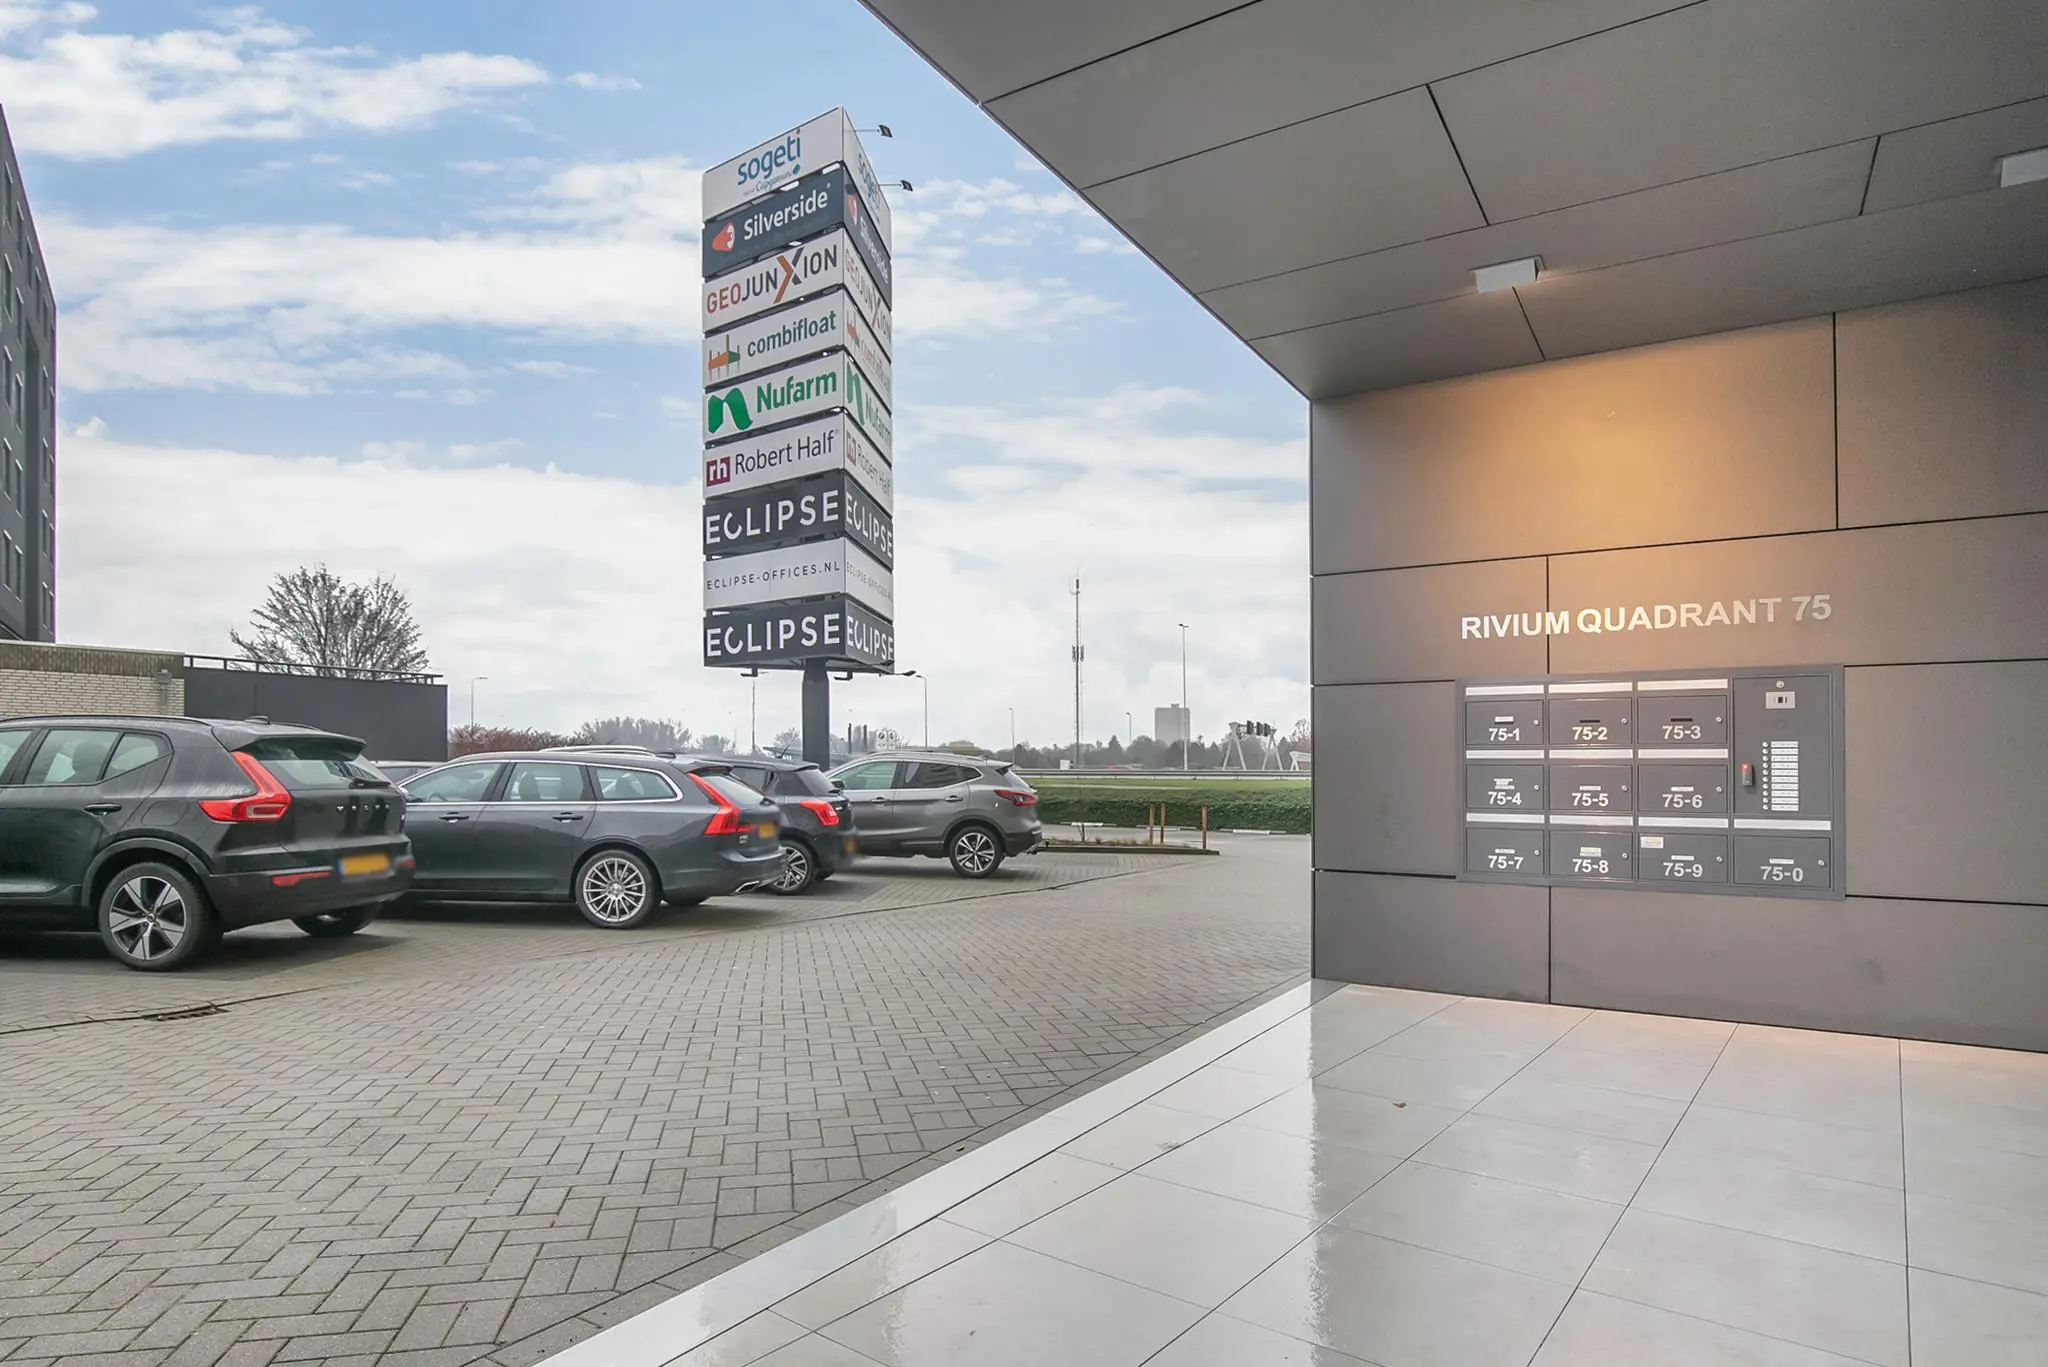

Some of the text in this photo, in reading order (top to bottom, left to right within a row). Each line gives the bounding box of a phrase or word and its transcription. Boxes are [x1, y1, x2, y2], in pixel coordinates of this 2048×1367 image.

[737, 128, 801, 186] sogeti
[743, 189, 828, 241] Silverside
[706, 246, 838, 314] GEOJUNXION
[747, 310, 837, 358] combifloat
[757, 371, 838, 413] Nufarm
[735, 446, 792, 475] Robert
[797, 431, 835, 460] Half
[706, 490, 839, 545] ECLIPSE
[845, 491, 893, 558] ECLIPSE
[706, 562, 841, 590] ECLIPSE-OFFICES.NL
[1461, 594, 1833, 640] RIVIUM QUADRANT 75
[706, 613, 841, 657] ECLIPSE
[846, 614, 894, 661] ECLIPSE
[1488, 728, 1521, 742] 75-1
[1572, 727, 1608, 741] 75-2
[1662, 726, 1702, 740] 75-3
[1488, 791, 1522, 806] 75-4
[1571, 792, 1609, 807] 75-5
[1662, 793, 1703, 809] 75-6
[1488, 855, 1524, 870] 75-7
[1572, 858, 1609, 874] 75-8
[1663, 862, 1704, 878] 75-9
[1760, 866, 1804, 882] 75-0
